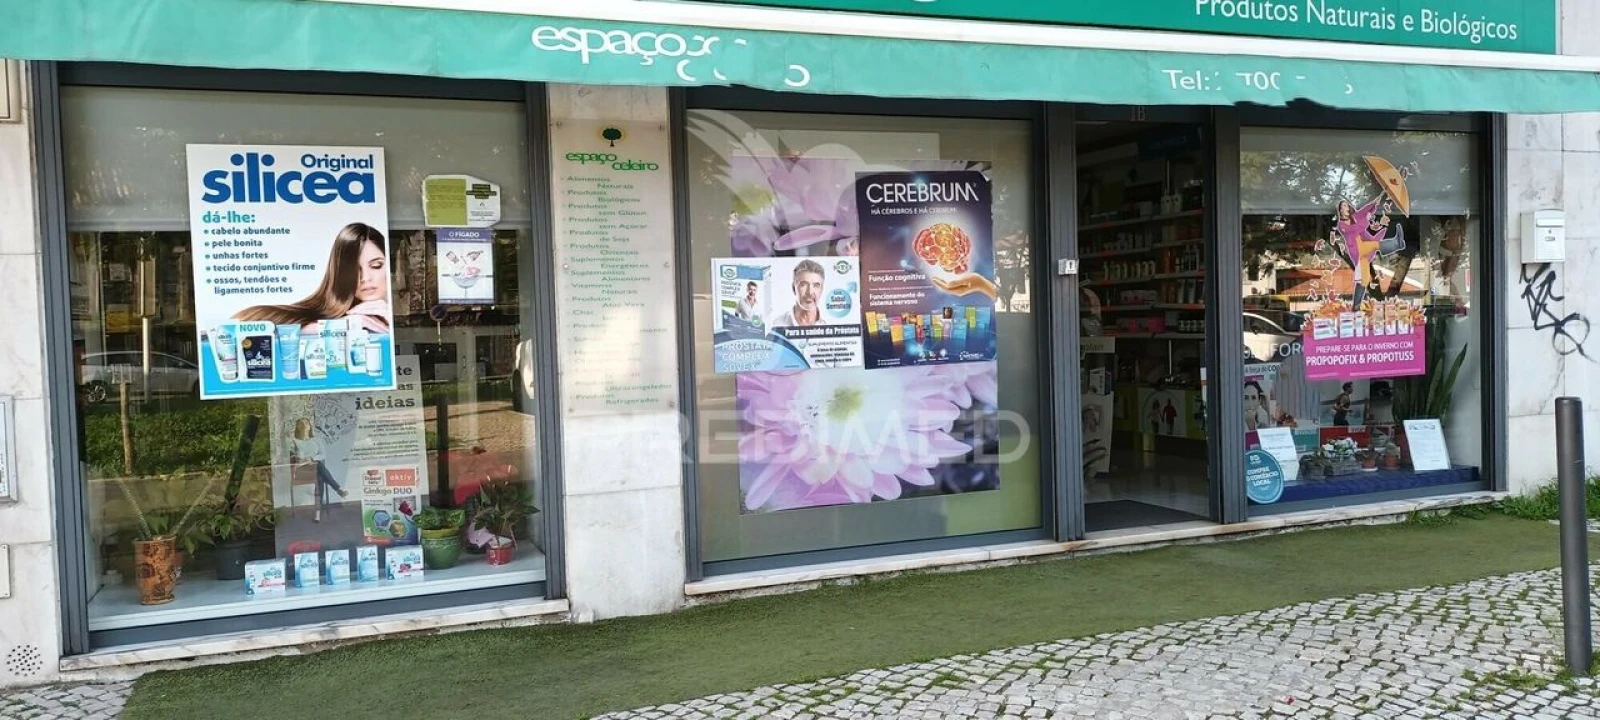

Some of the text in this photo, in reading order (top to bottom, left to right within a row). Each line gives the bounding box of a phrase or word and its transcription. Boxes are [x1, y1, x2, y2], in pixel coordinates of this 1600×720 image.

[1195, 0, 1518, 44] Produtos Naturais e Biológicos
[531, 24, 687, 65] espaço
[300, 153, 374, 172] Original
[565, 153, 618, 165] espaço
[611, 159, 659, 171] celeiro
[201, 152, 376, 204] silicea
[866, 181, 980, 204] CEREBRUM
[202, 210, 256, 224] dá-lhe:
[211, 226, 290, 235] cabelo abundante
[212, 238, 263, 249] pele bonita
[212, 251, 269, 260] unhas fortes
[213, 263, 316, 273] tecido conjuntivo firme
[214, 275, 288, 286] ossos, tendões e
[868, 272, 926, 283] Função cognitiva
[214, 285, 293, 295] ligamentos fortes
[239, 323, 266, 332] NOVO
[785, 329, 800, 337] Para
[805, 327, 825, 336] saúde
[834, 326, 860, 335] Próstata
[1315, 340, 1414, 353] PREPARE-SE PARA O INVERNO COM
[1305, 350, 1415, 366] PROPOPOFIX & PROPOTUSS
[354, 395, 416, 411] ideias
[363, 486, 413, 496] Ginkgo DUO
